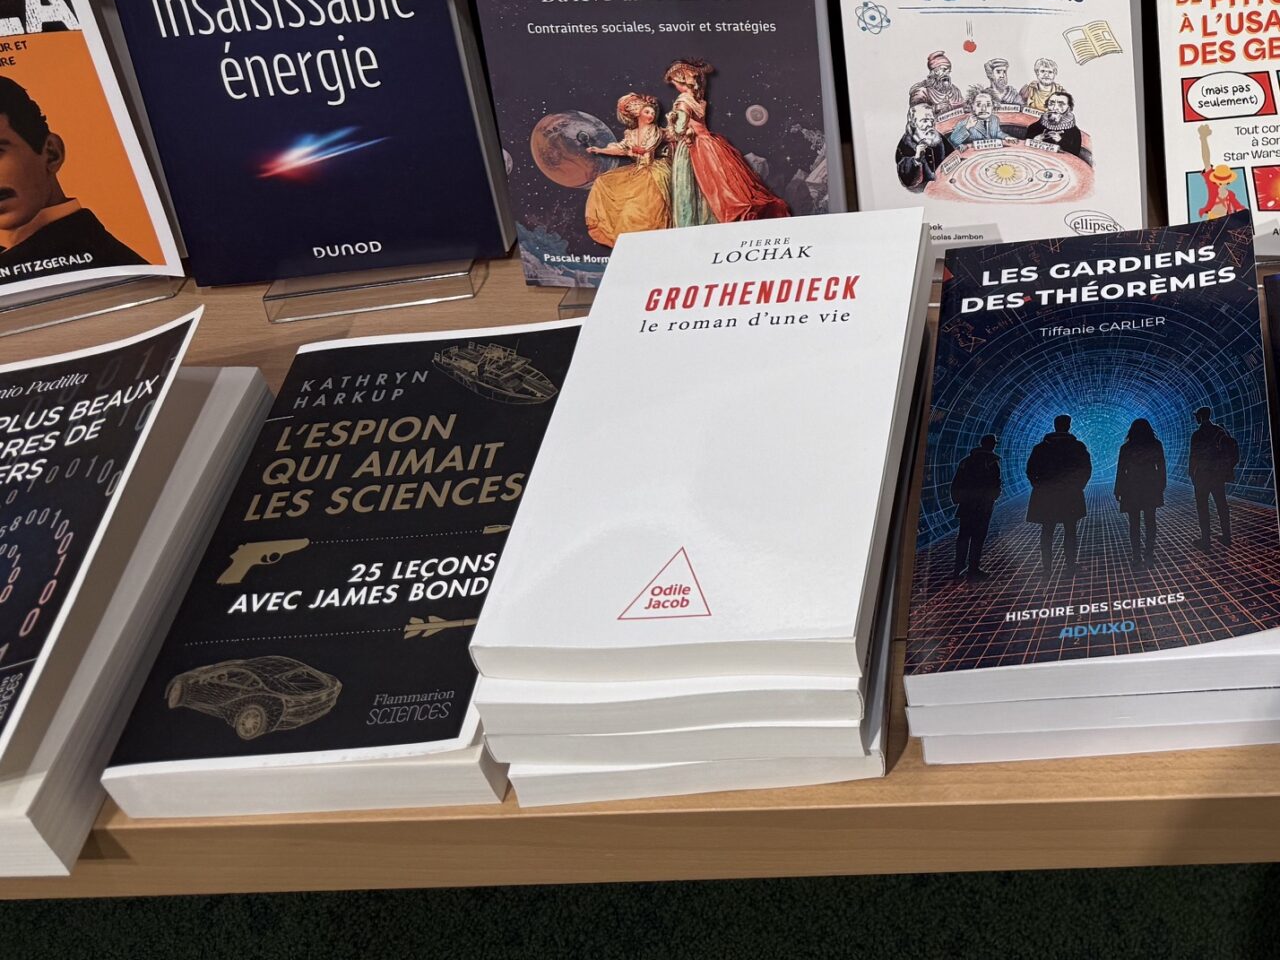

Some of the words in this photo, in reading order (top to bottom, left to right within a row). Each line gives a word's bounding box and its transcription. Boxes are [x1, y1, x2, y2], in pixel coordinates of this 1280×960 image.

[527, 22, 598, 34] Contraintes
[602, 21, 654, 34] sociales,
[659, 21, 695, 32] savoir
[700, 21, 712, 31] et
[716, 20, 776, 34] stratégies
[1179, 13, 1194, 33] À
[1179, 41, 1237, 66] DES
[220, 35, 382, 106] énergie
[313, 241, 382, 259] DUNOD
[711, 246, 812, 265] LOCHAK
[14, 252, 94, 274] FITZGERALD
[981, 266, 1039, 287] LES
[1049, 245, 1216, 281] GARDIENS
[645, 275, 861, 312] GROTHENDIECK
[960, 292, 1026, 314] DES
[1035, 266, 1236, 305] THÉORÈMES
[640, 318, 658, 333] le
[667, 315, 737, 331] roman
[748, 312, 809, 326] d'une
[819, 309, 851, 323] vie
[301, 371, 428, 392] KATHRYN
[293, 389, 406, 409] HARKUP
[275, 414, 456, 451] L'ESPION
[261, 454, 339, 486] QUI
[352, 442, 504, 478] AIMAIT
[243, 490, 323, 522] LES
[330, 473, 525, 513] SCIENCES
[348, 563, 384, 583] 25
[393, 553, 497, 580] LEÇONS
[228, 591, 302, 615] AVEC
[308, 584, 397, 610] JAMES
[408, 577, 490, 601] BOND
[650, 584, 691, 597] Odile
[644, 596, 690, 610] Jacob
